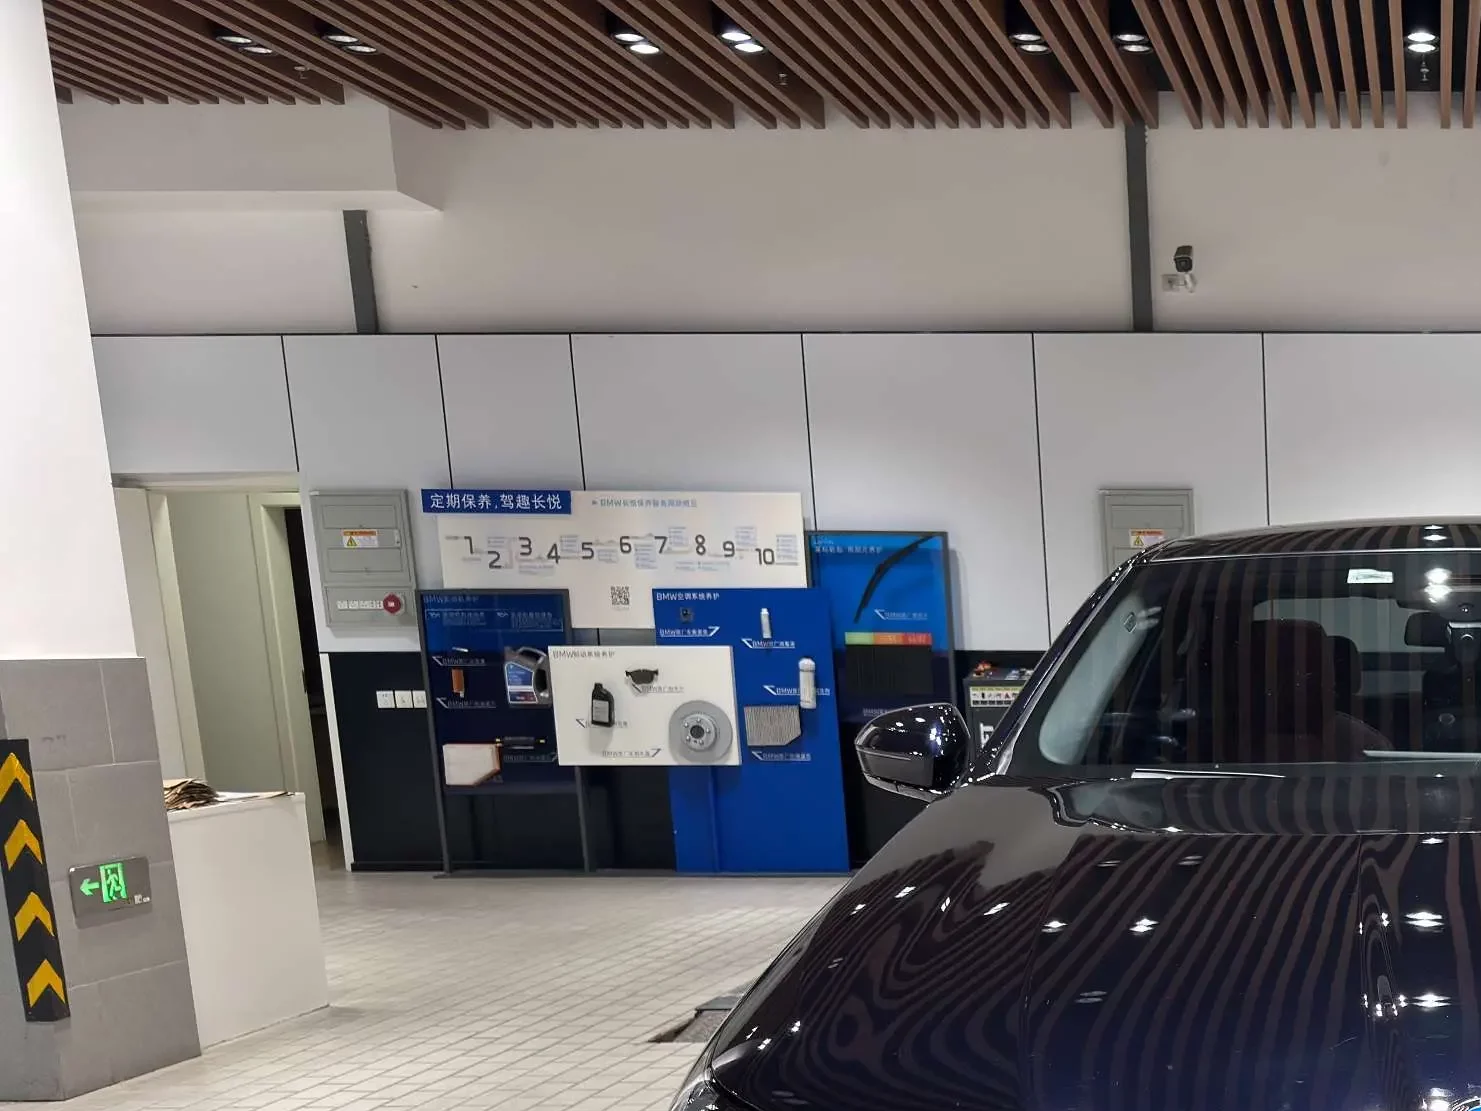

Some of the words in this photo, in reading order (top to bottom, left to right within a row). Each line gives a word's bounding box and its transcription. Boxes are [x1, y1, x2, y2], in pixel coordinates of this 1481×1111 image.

[488, 551, 501, 569] 2
[519, 537, 532, 555] 3
[547, 544, 560, 564] 4
[581, 542, 594, 559] 5
[619, 536, 631, 554] 6
[654, 536, 668, 553] 7
[695, 534, 706, 556] 8
[722, 541, 735, 557] 9
[755, 548, 775, 565] 10
